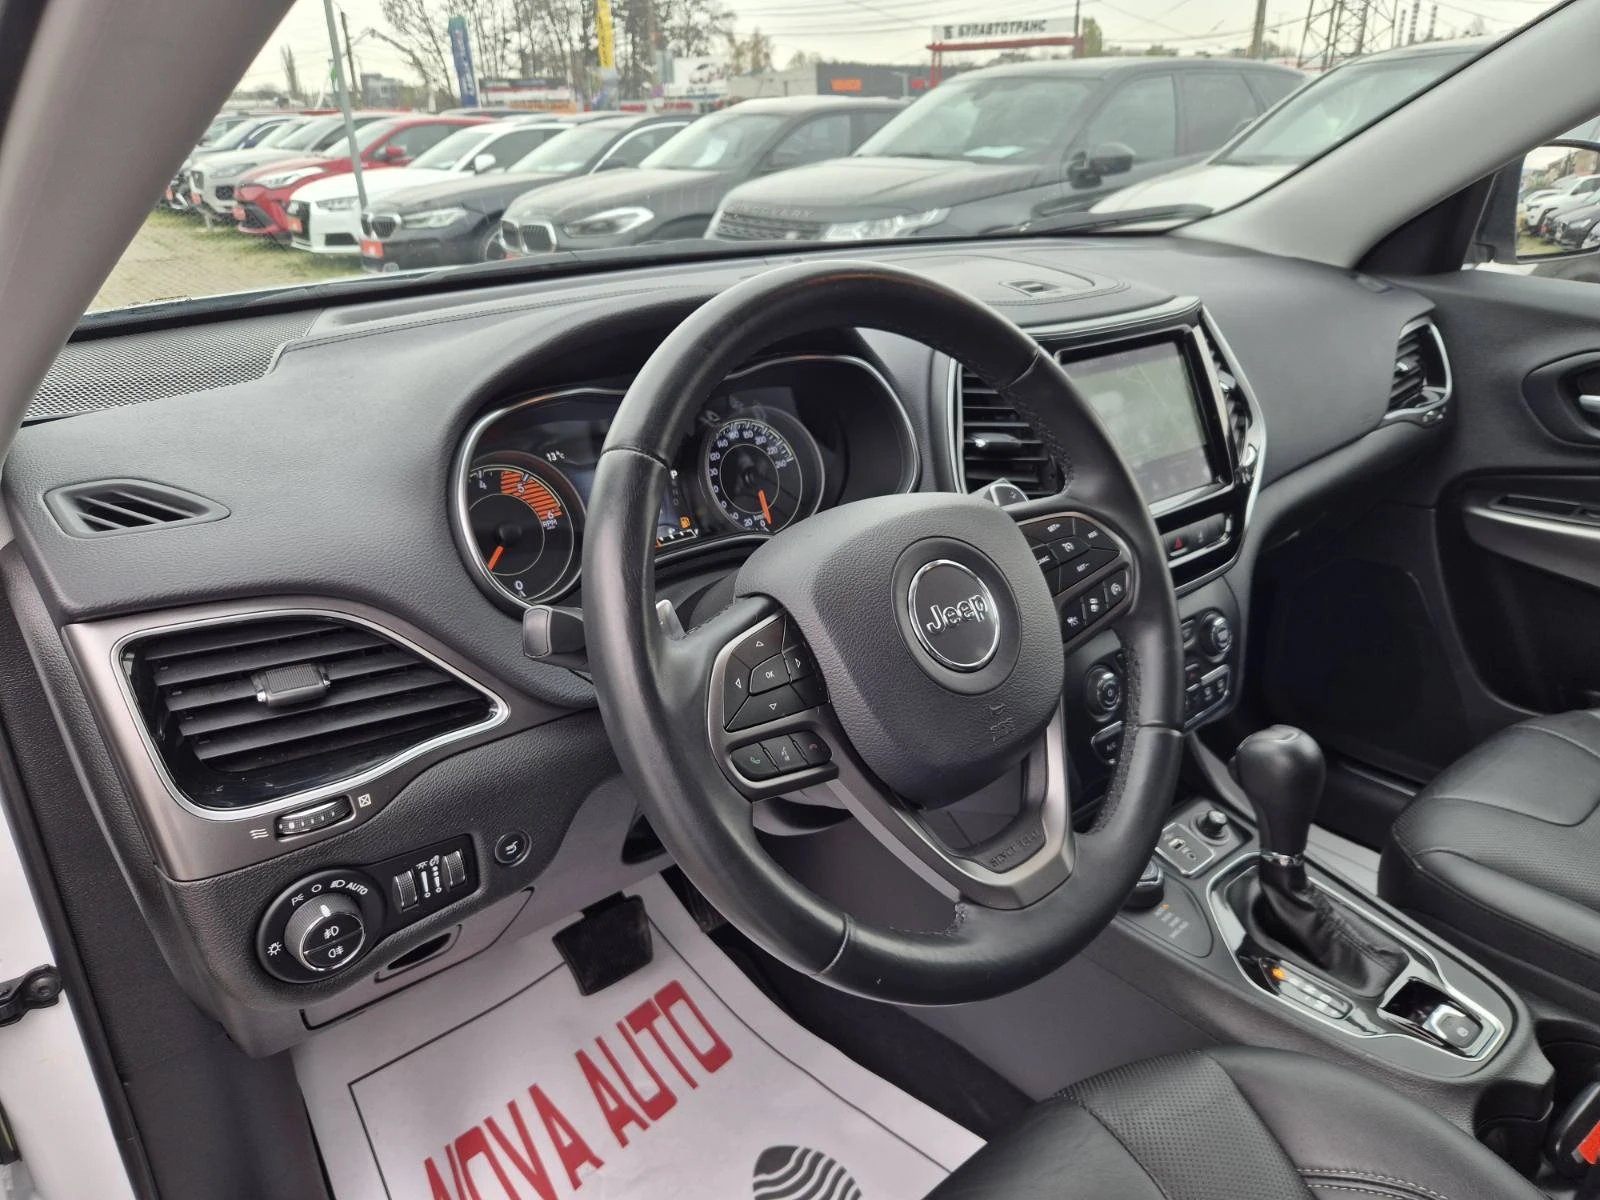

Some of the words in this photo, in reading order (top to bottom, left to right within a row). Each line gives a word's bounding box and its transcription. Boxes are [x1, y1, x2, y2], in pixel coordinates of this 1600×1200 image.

[517, 483, 526, 493] 5
[547, 511, 555, 519] 6
[542, 519, 558, 528] RPM
[926, 594, 989, 633] Jeep
[765, 670, 775, 679] OK
[346, 882, 368, 895] AUTO
[574, 980, 733, 1148] AUTO
